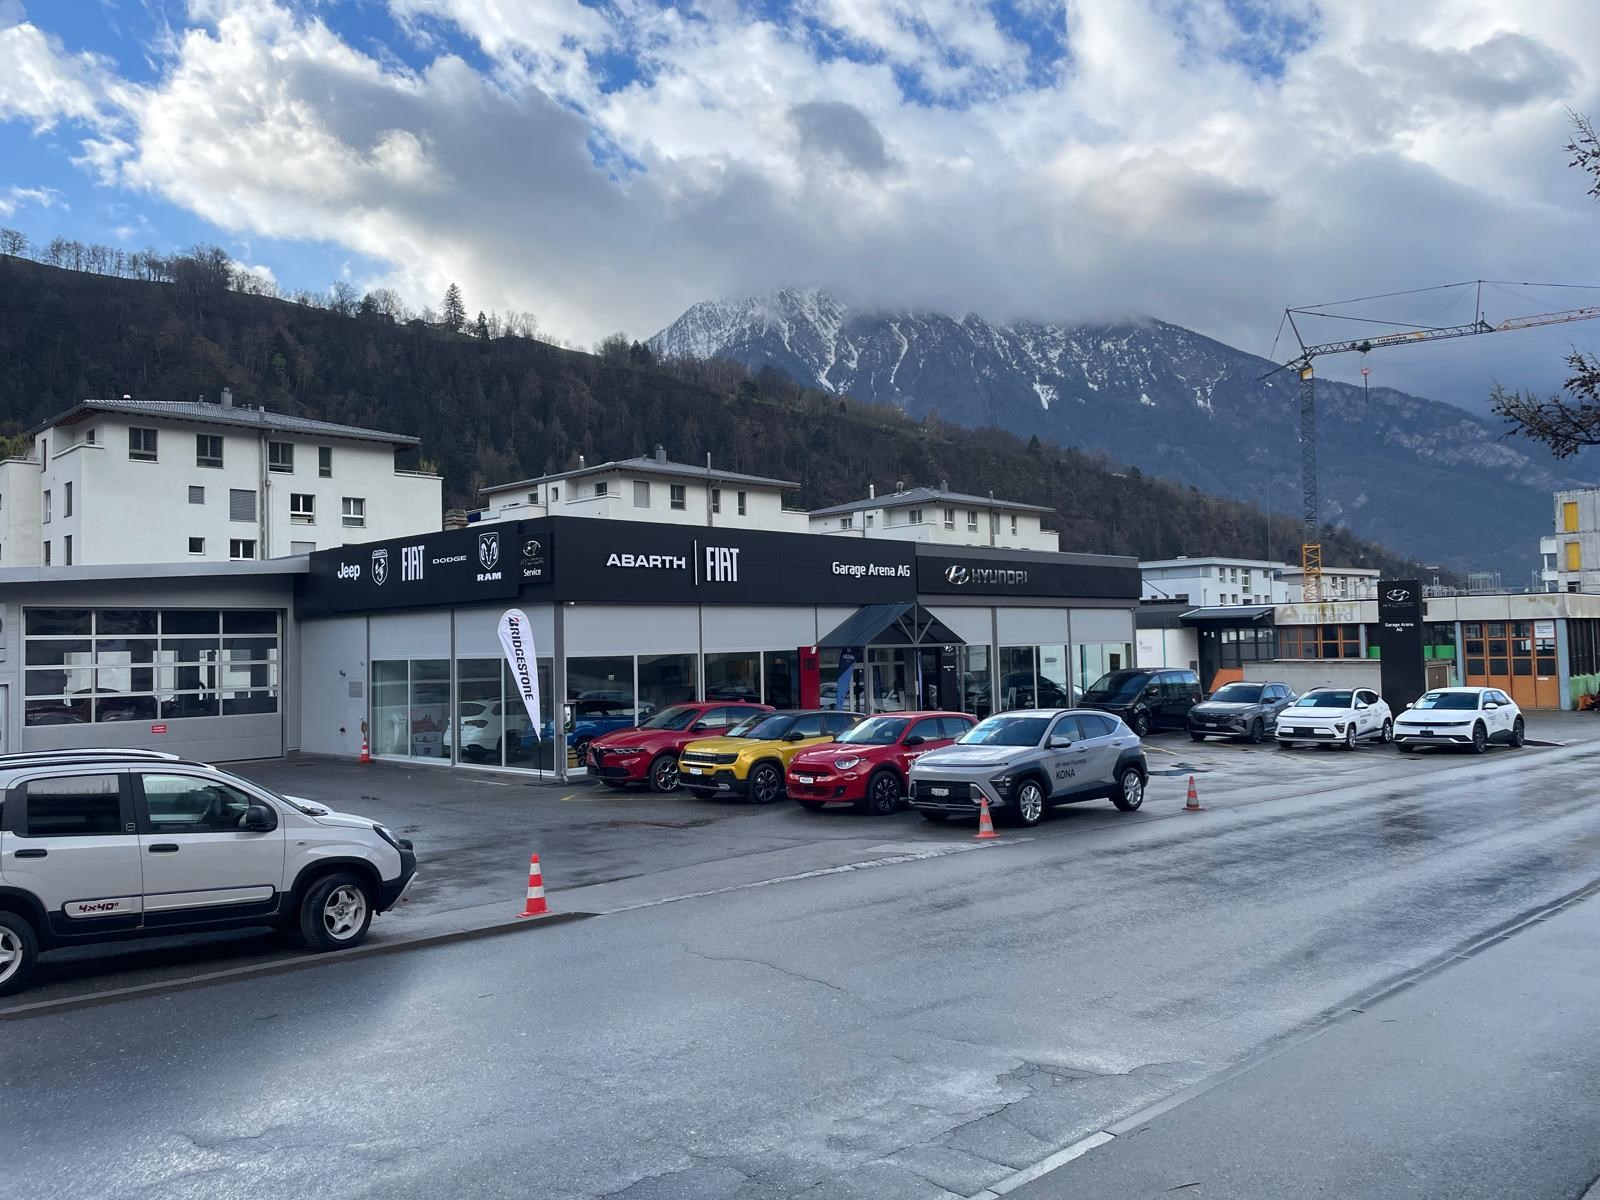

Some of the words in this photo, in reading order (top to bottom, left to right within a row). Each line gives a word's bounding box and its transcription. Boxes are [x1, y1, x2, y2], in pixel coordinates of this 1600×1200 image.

[401, 545, 425, 581] FIAT
[432, 555, 467, 564] DODGE
[606, 553, 686, 569] ABARTH
[706, 547, 739, 582] FIAT
[337, 562, 361, 580] Jeep
[476, 571, 502, 582] RAM
[523, 568, 542, 577] Service
[832, 561, 866, 578] Garage
[868, 563, 894, 577] Arena
[897, 565, 910, 578] AG
[971, 569, 1028, 585] HYUNDAI
[508, 616, 534, 701] BRIDGESTONE
[1055, 768, 1076, 780] KONA
